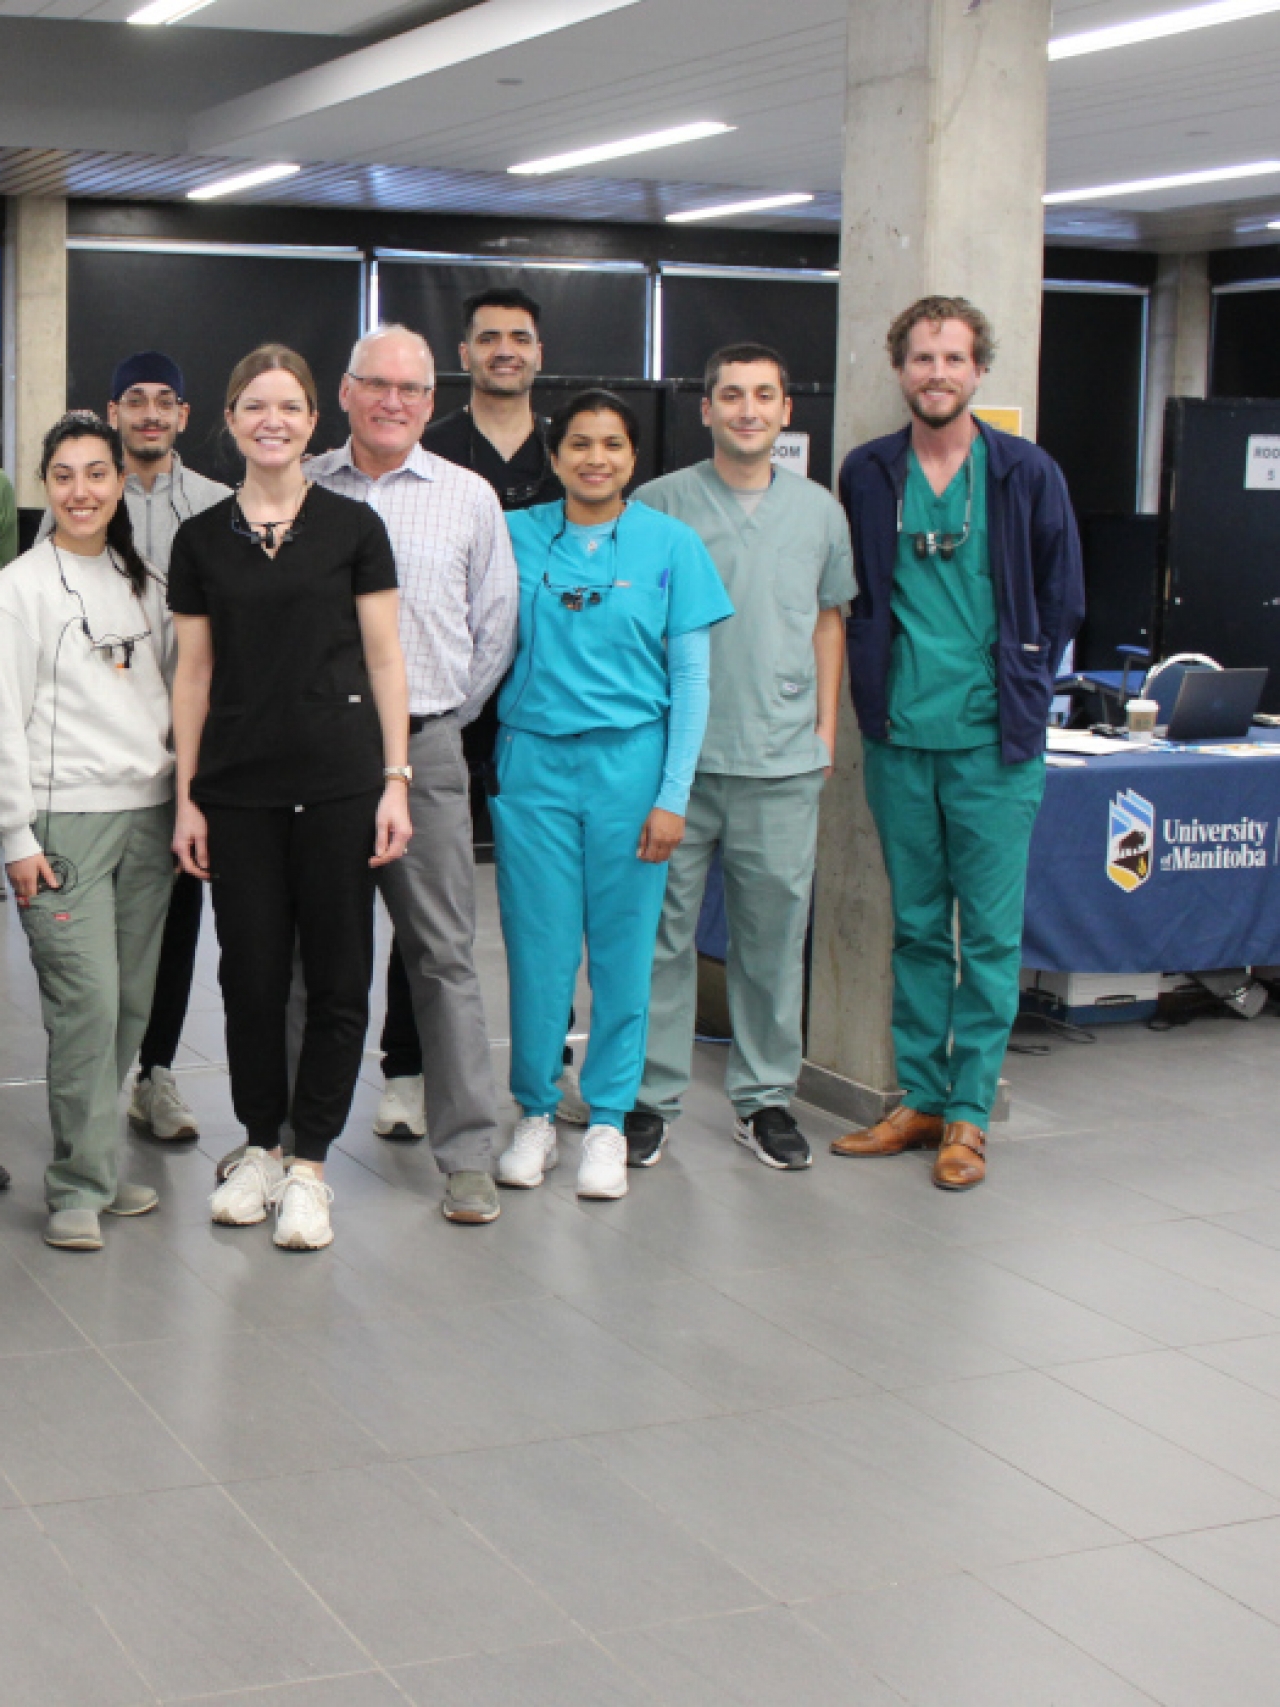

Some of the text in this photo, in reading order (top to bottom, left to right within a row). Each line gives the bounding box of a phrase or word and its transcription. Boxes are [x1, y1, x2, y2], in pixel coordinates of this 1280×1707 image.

[1253, 447, 1280, 459] ROO
[1163, 817, 1268, 847] University
[1172, 844, 1267, 870] Manitoba
